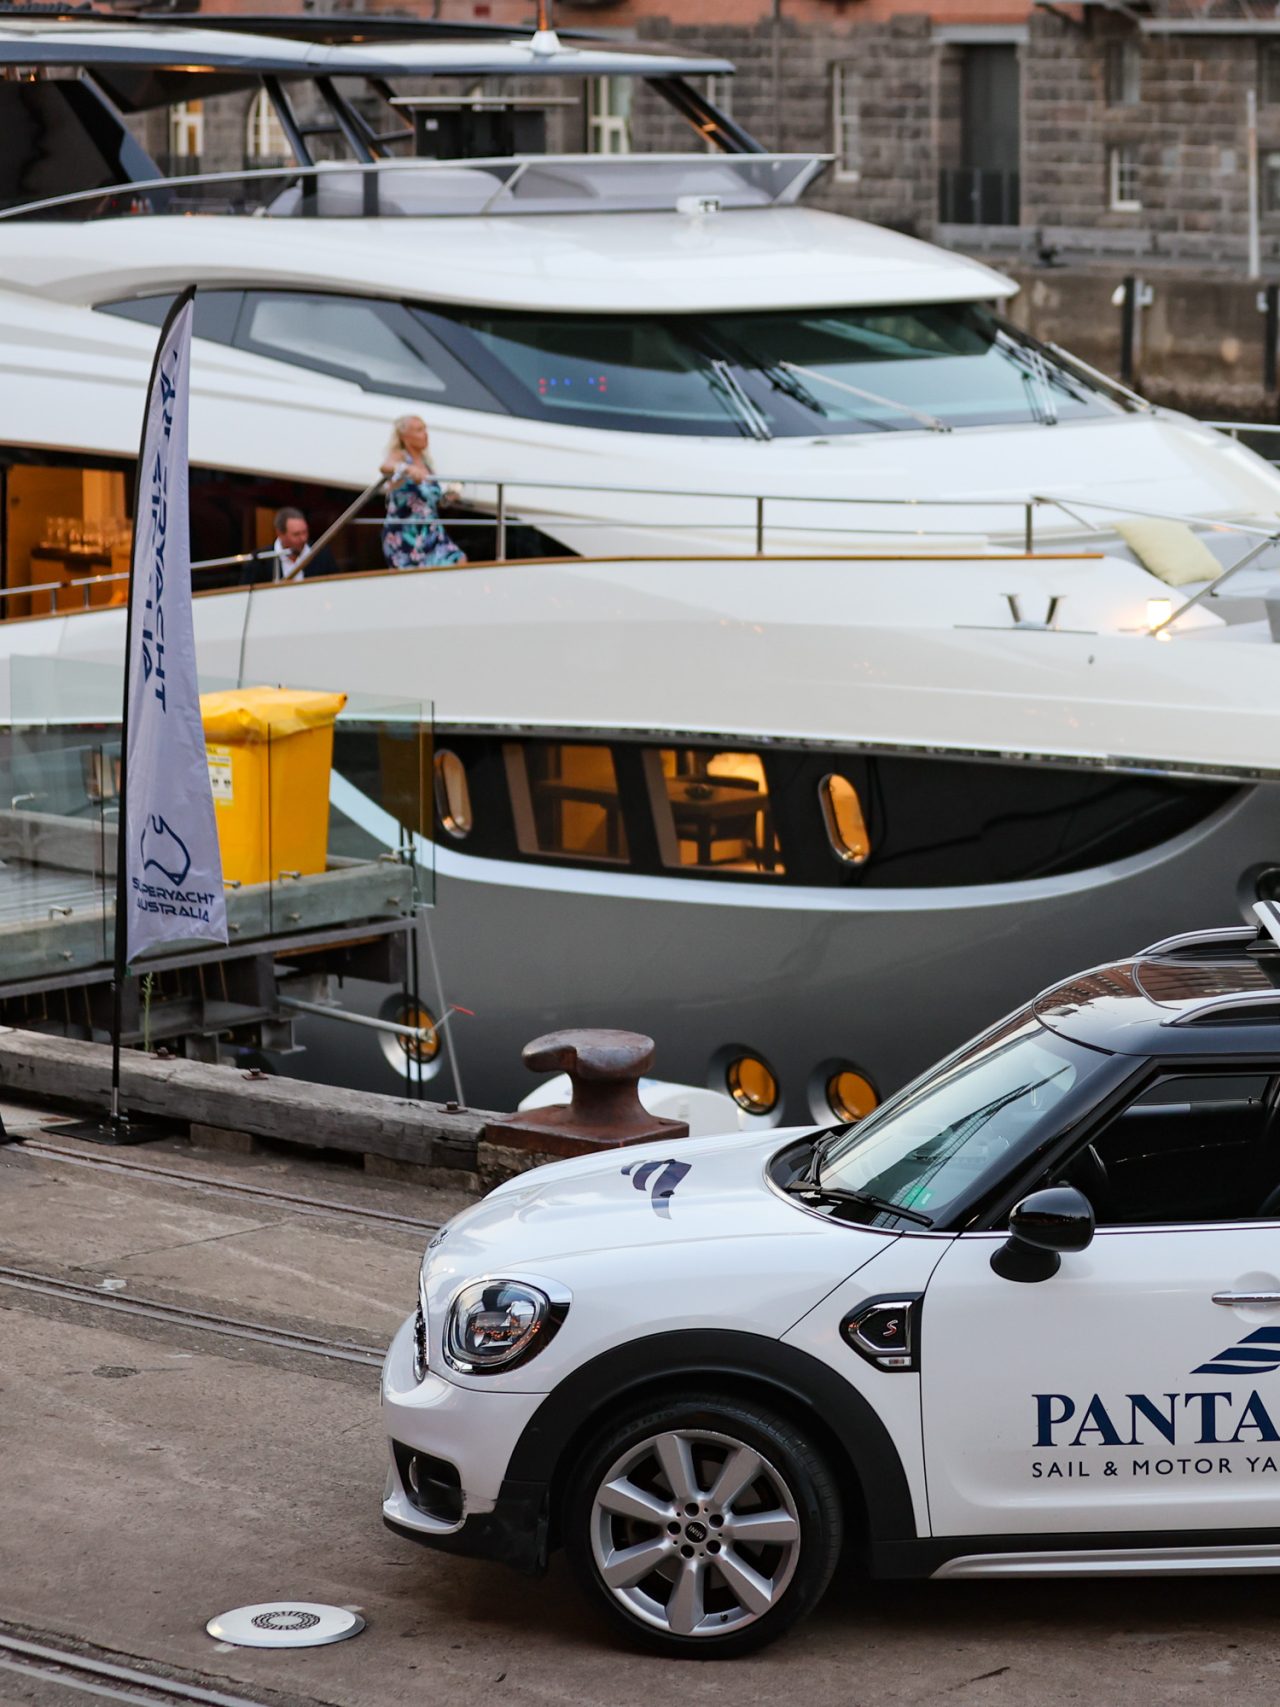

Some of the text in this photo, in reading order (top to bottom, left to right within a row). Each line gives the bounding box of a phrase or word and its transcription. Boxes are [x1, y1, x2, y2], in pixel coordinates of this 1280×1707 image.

[155, 350, 177, 713] RYACHT
[1031, 1460, 1091, 1479] SAIL
[1103, 1460, 1119, 1477] &
[1132, 1457, 1233, 1476] MOTOR
